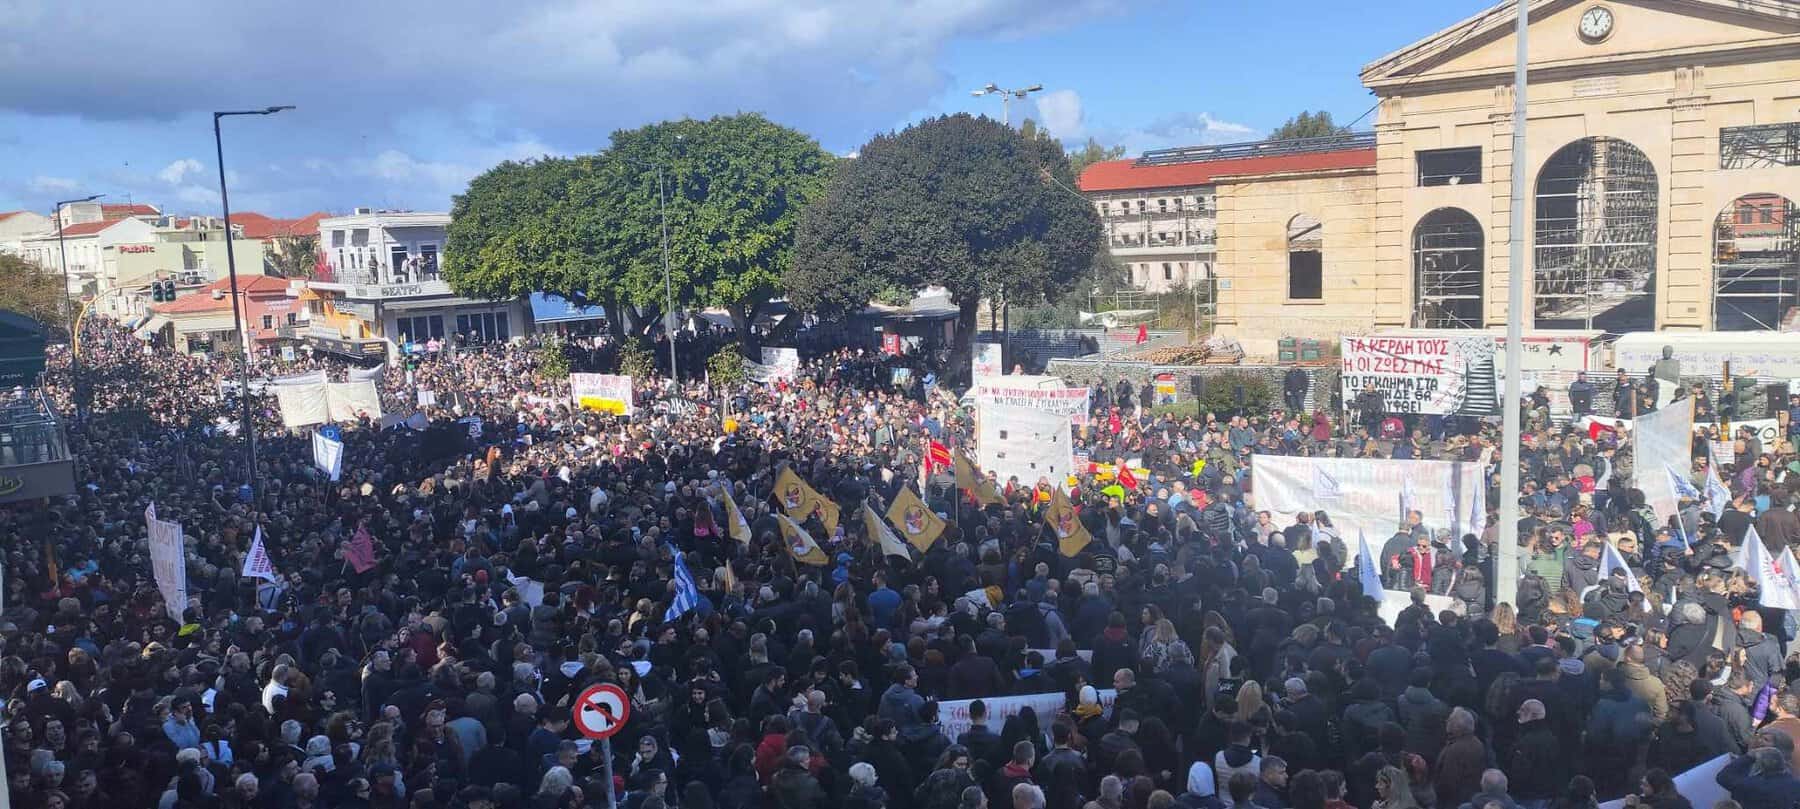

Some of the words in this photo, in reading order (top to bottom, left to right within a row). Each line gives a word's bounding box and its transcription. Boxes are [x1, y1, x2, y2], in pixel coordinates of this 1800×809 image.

[119, 244, 156, 254] Public
[1349, 339, 1365, 351] ΤΑ
[1370, 339, 1415, 355] ΚΕΡΔΗ
[1417, 339, 1449, 355] ΤΟΥΣ
[1344, 358, 1353, 372] Η
[1357, 358, 1371, 372] ΟΙ
[1374, 358, 1409, 374] ΖΩΕΣ
[1413, 359, 1446, 375] ΜΑΣ
[1342, 376, 1359, 388] ΤΟ
[1416, 378, 1438, 391] ΣΤΑ
[1393, 389, 1410, 400] ΔΕ
[1414, 390, 1432, 401] ΘΑ
